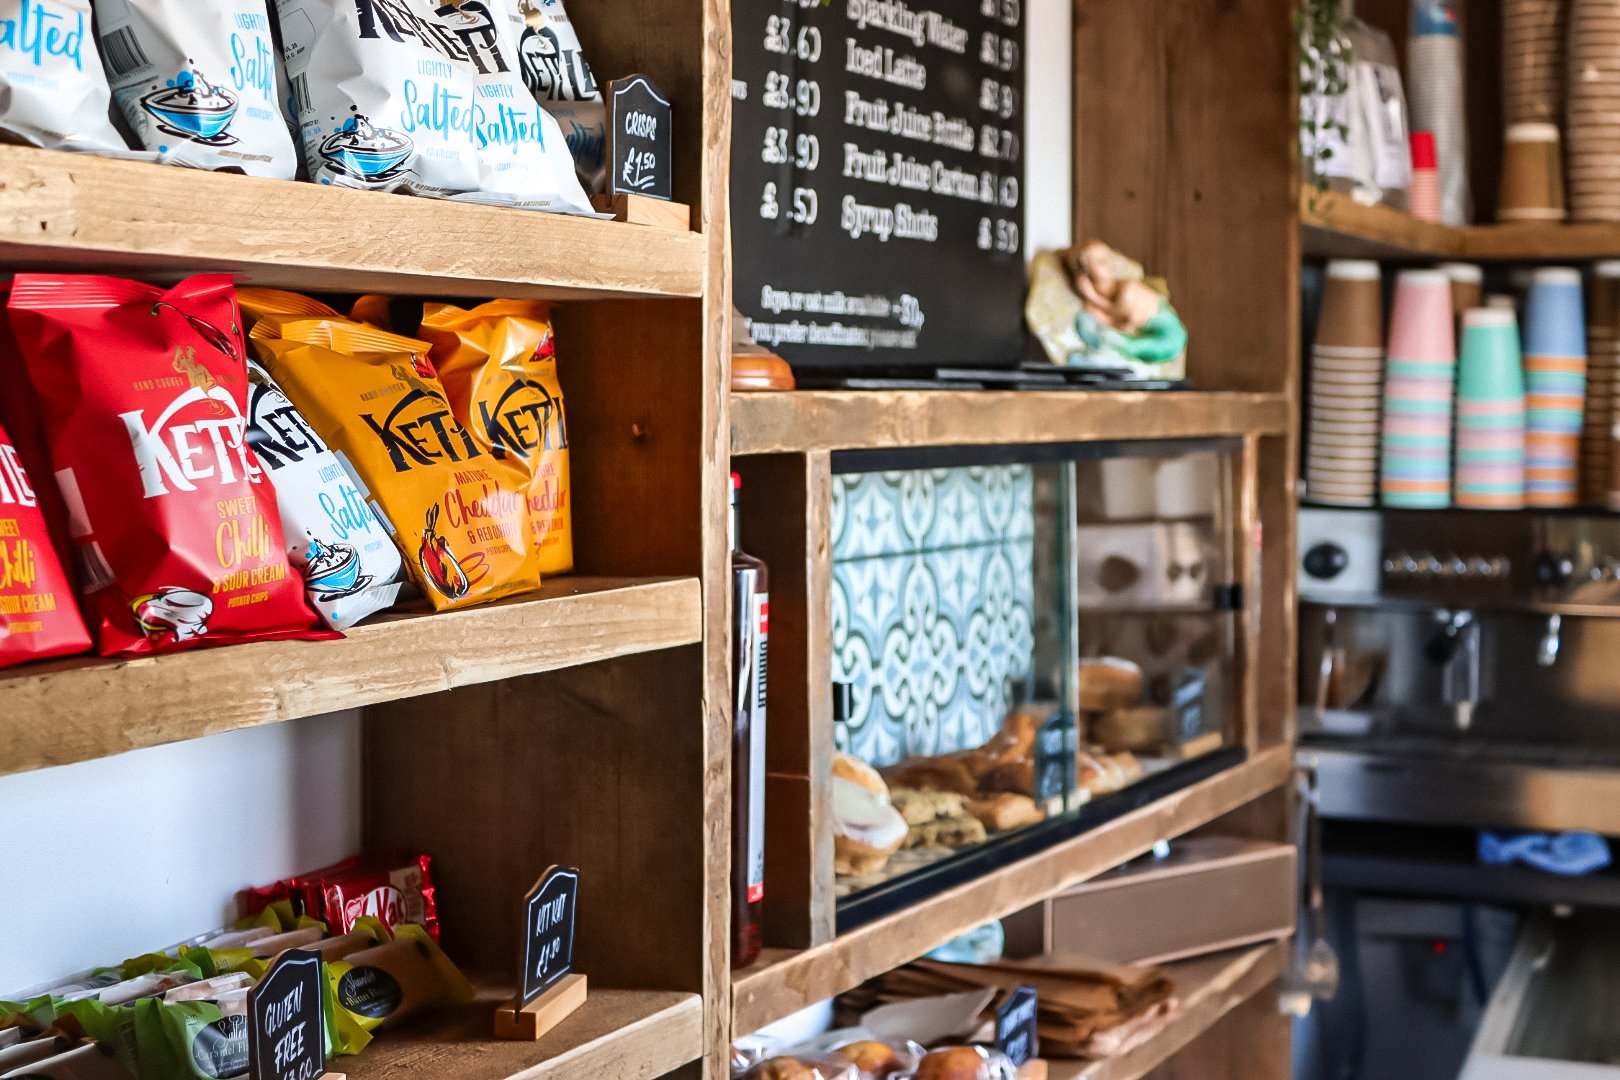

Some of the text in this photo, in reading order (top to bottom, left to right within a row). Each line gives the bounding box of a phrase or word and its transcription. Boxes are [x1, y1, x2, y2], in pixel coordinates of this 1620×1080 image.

[0, 0, 84, 72] alted
[234, 12, 267, 30] LIGHT
[230, 32, 273, 100] Salt
[418, 59, 453, 78] LIGHTLY
[845, 37, 883, 80] Iced
[400, 79, 475, 144] Salted
[477, 84, 514, 98] LIGHTLY
[844, 90, 889, 132] Fruit
[474, 102, 546, 155] Salted
[625, 111, 657, 140] CRISPS
[623, 147, 656, 187] £1.50
[843, 142, 887, 183] Fruit
[841, 195, 894, 242] Syrup
[358, 389, 482, 473] KETT
[318, 462, 345, 483] LIGHTL
[454, 469, 492, 486] MATURE
[216, 496, 257, 518] SWEET
[444, 480, 520, 528] Cheddar
[216, 513, 270, 568] Chilli
[0, 539, 36, 590] hilli
[222, 571, 249, 593] SOUR
[251, 563, 285, 586] CREAM
[228, 591, 269, 608] POTATO CHIPS
[264, 980, 304, 1038] GLUTEN
[274, 1021, 307, 1073] FREE
